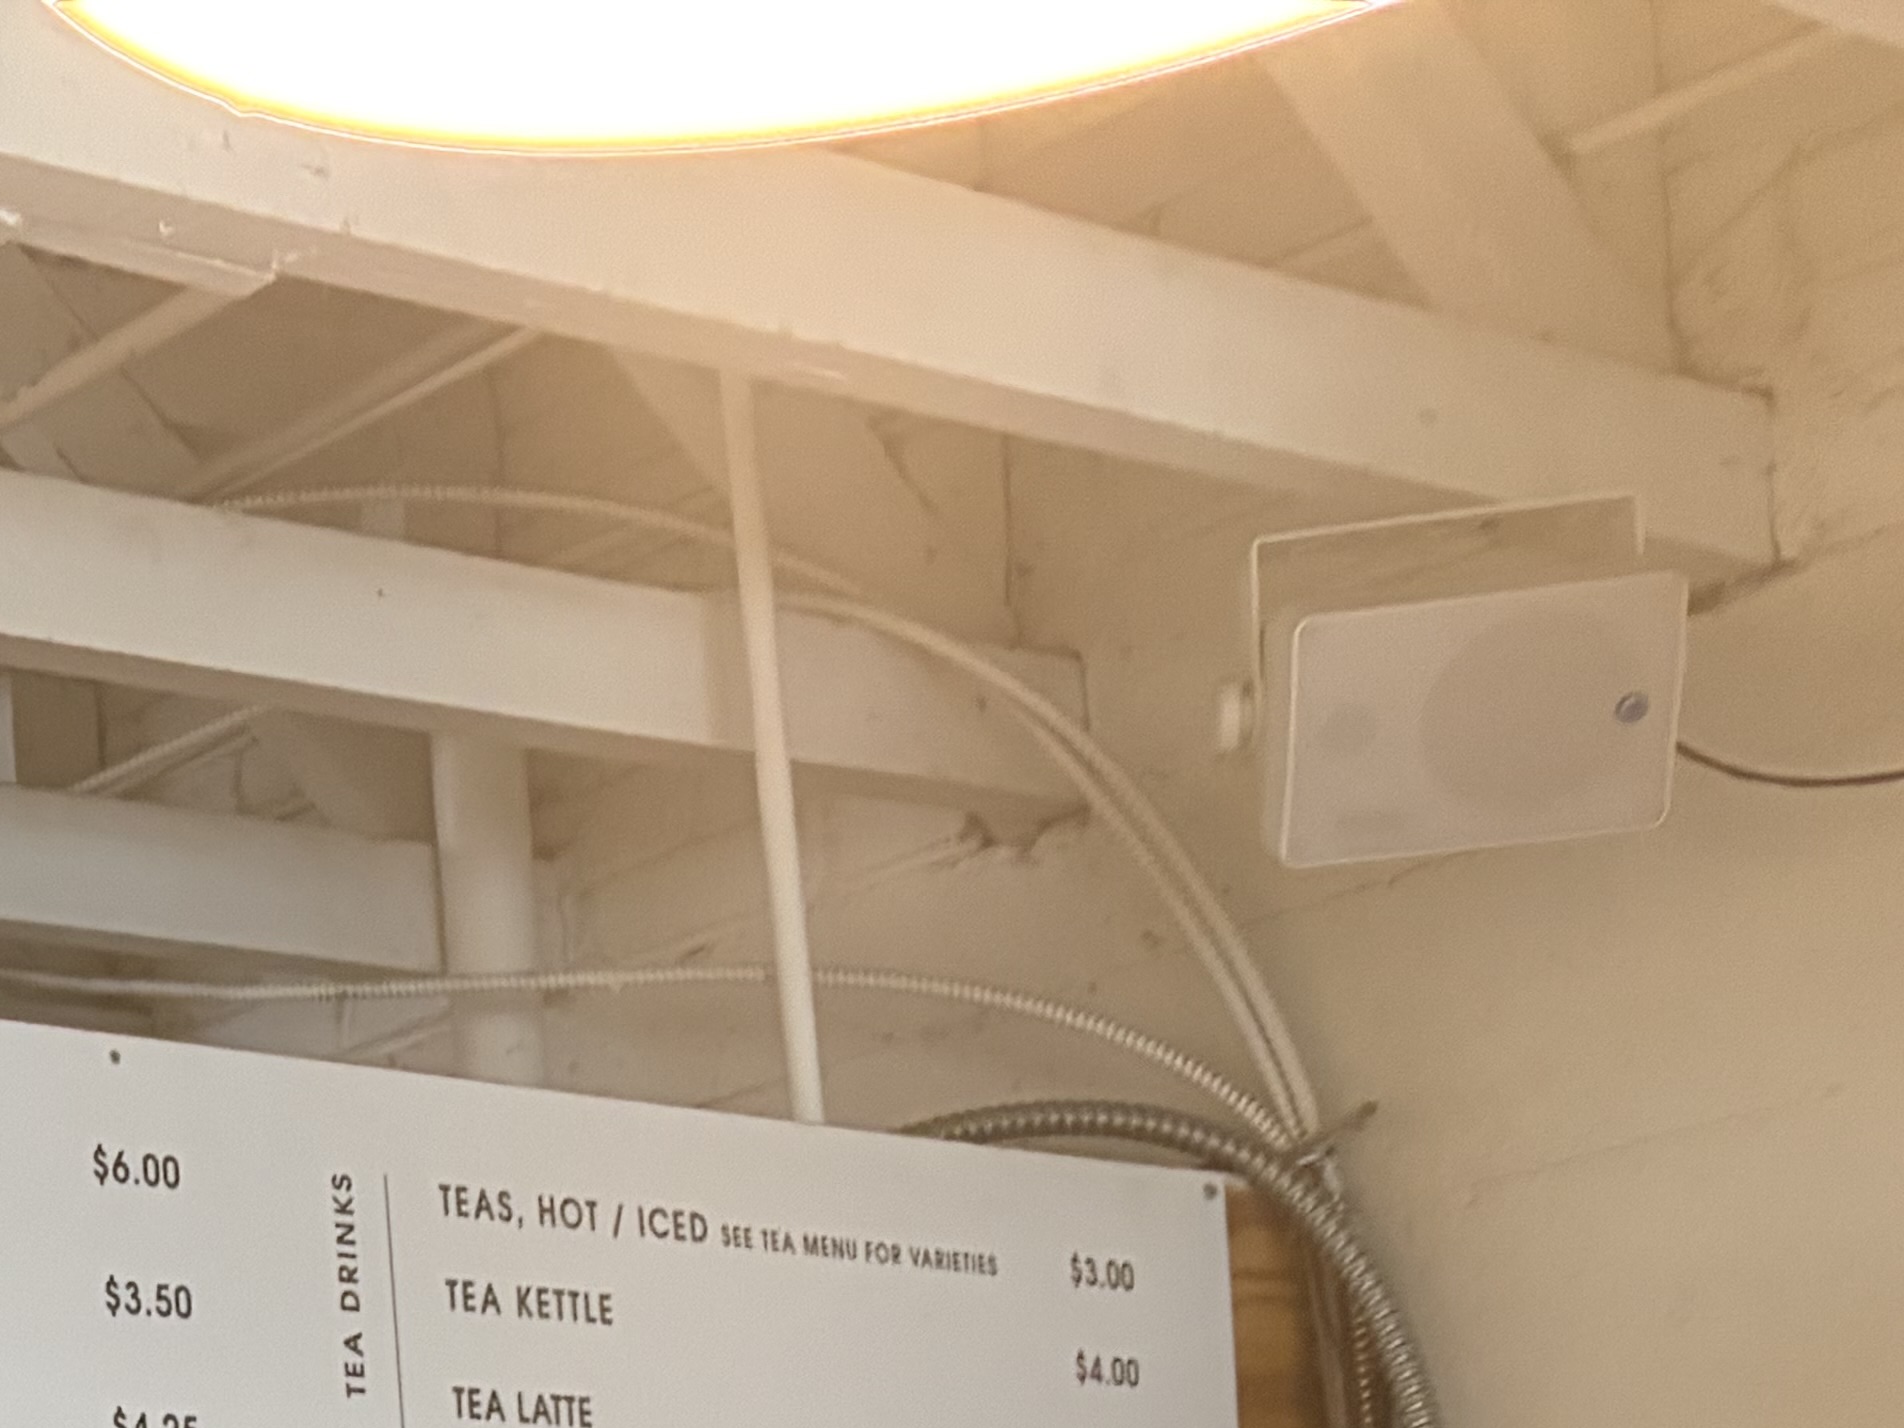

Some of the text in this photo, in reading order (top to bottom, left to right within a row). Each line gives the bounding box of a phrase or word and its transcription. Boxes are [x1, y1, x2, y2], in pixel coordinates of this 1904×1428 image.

[92, 1142, 182, 1191] $6.00
[104, 1273, 194, 1321] $3.50
[329, 1172, 368, 1400] TEA DRINKS
[443, 1277, 614, 1327] TEA KETTLE
[1075, 1349, 1141, 1389] $4.00
